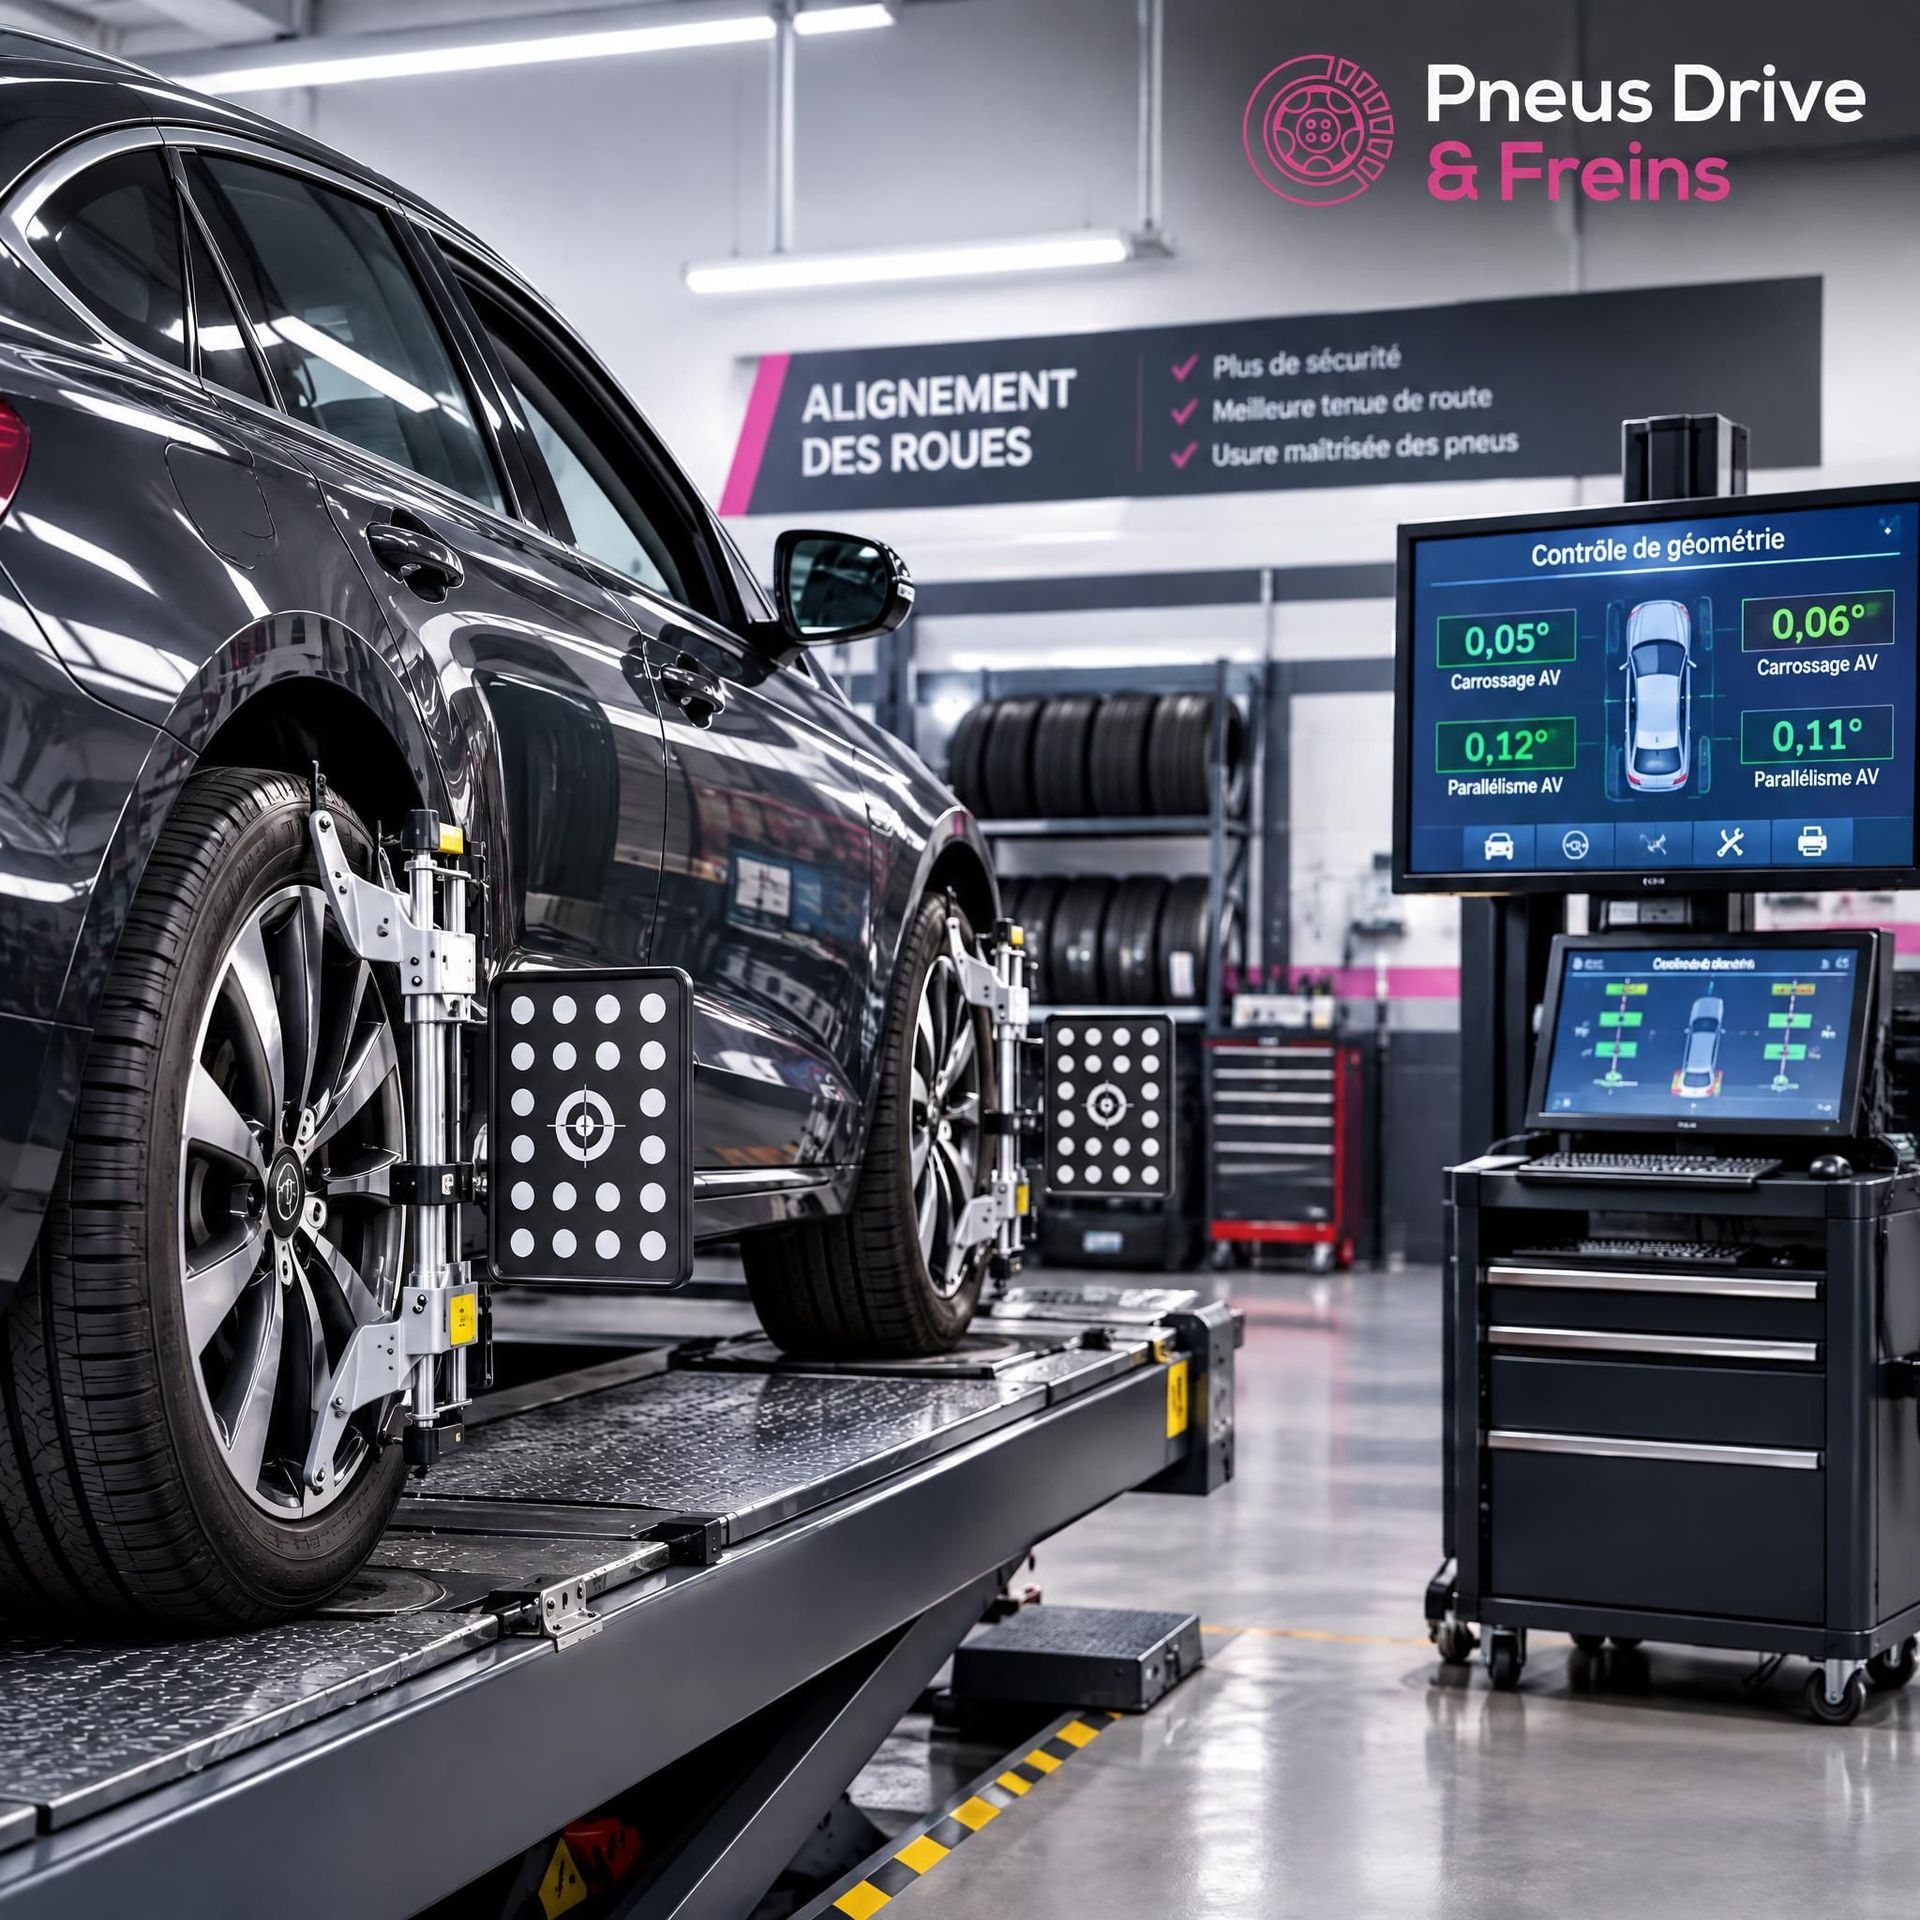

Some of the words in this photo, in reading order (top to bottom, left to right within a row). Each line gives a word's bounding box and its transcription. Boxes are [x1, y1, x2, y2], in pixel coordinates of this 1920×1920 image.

[1213, 353, 1264, 380] Plus
[1269, 351, 1300, 376] de
[1305, 343, 1402, 374] sécurité
[801, 368, 1078, 423] ALIGNEMENT
[1212, 395, 1316, 423] Meilleure
[1321, 394, 1388, 417] tenue
[1393, 387, 1424, 413] de
[1429, 385, 1493, 411] route
[802, 434, 882, 477] DES
[890, 426, 1033, 473] ROUES
[1212, 442, 1279, 467] Usure
[1284, 434, 1391, 464] maîtrisée
[1396, 432, 1439, 458] des
[1444, 431, 1520, 462] pneus
[1633, 536, 1661, 559] de
[1667, 527, 1785, 562] géométrie
[1465, 621, 1550, 660] 0,05°
[1772, 603, 1865, 644] 0,06°
[1451, 673, 1536, 692] Carrossage
[1539, 669, 1561, 687] AV
[1757, 658, 1850, 676] Carrossage
[1854, 653, 1879, 671] AV
[1465, 729, 1548, 767] 0,12°
[1772, 718, 1862, 757] 0,11°
[1448, 777, 1538, 796] Parallélisme
[1541, 776, 1564, 793] AV
[1754, 769, 1852, 788] Parallélisme
[1856, 768, 1880, 785] AV
